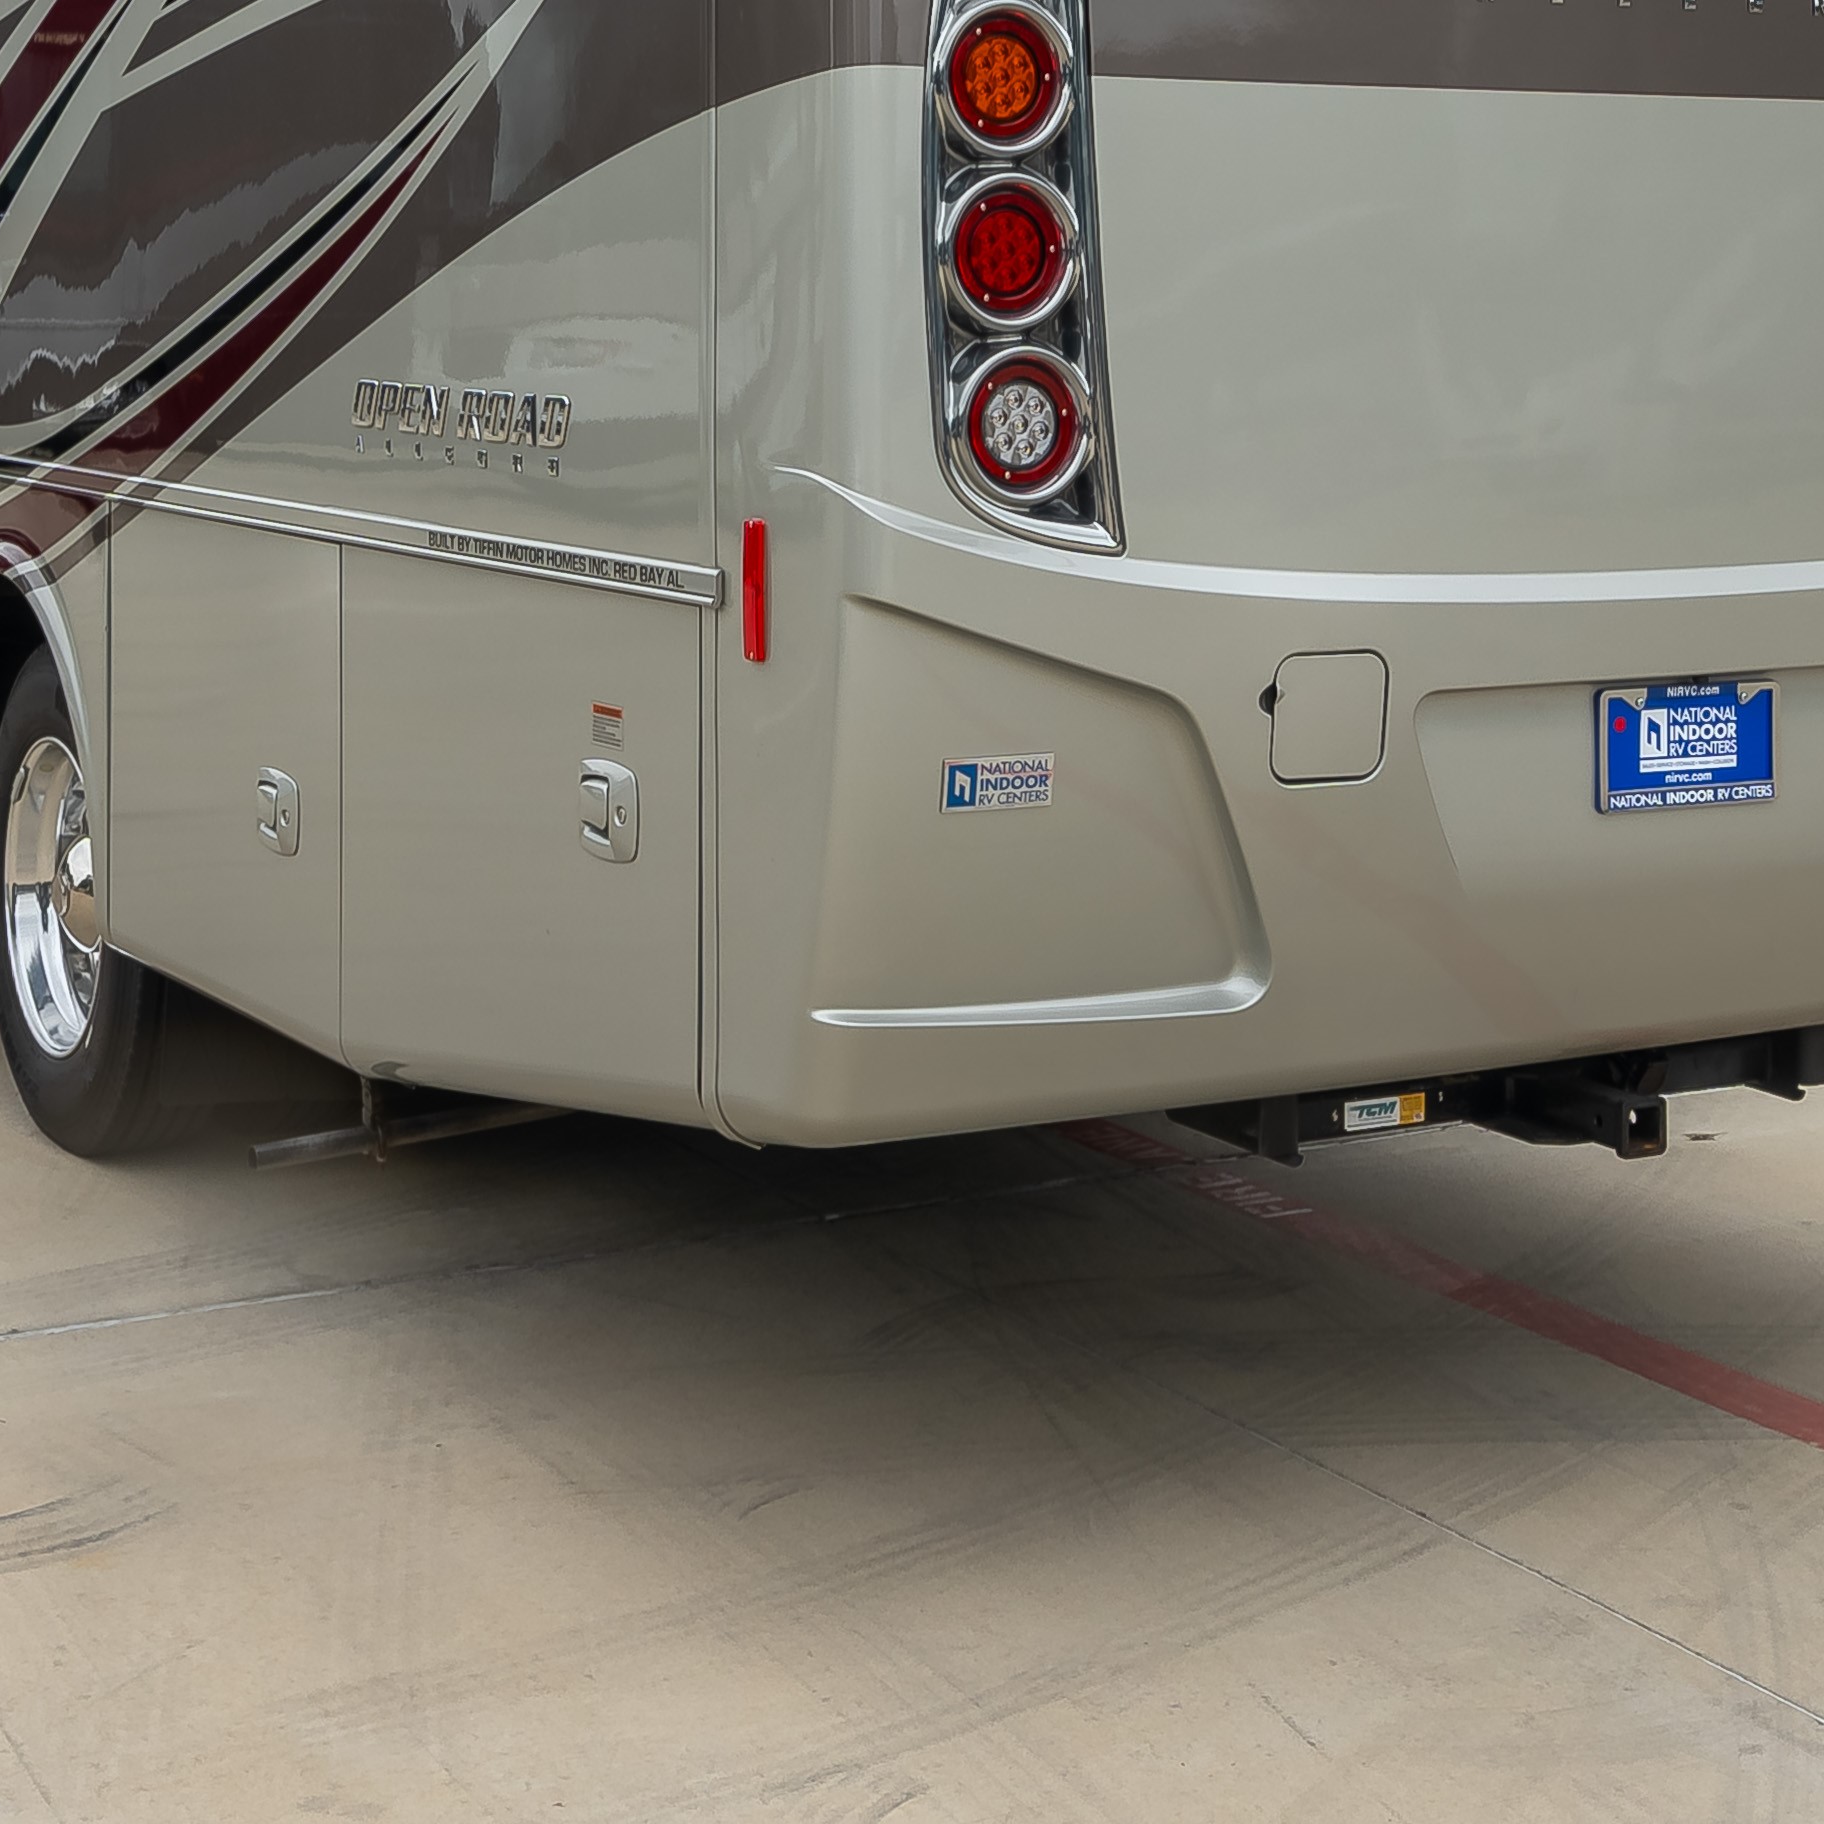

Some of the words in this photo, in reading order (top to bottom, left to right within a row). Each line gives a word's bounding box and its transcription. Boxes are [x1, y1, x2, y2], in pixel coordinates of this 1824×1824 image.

[352, 379, 450, 437] OPEN
[456, 388, 572, 449] ROAD
[429, 531, 456, 550] BUILT
[457, 535, 471, 552] BY
[474, 537, 504, 558] TIFFIN
[506, 542, 544, 564] MOTOR
[547, 549, 587, 572] HOMES
[613, 562, 638, 581] RED
[640, 566, 665, 585] BAY
[1667, 685, 1720, 698] NIRVC.com
[1670, 705, 1737, 723] NATIONAL
[1670, 723, 1737, 741] INDOOR
[1669, 742, 1686, 756] RV
[1687, 740, 1737, 756] CENTERS
[981, 759, 1049, 776] NATIONAL
[979, 774, 1049, 792] INDOOR
[1665, 772, 1712, 783] nirvc.com
[978, 793, 995, 806] RV
[997, 789, 1049, 805] CENTERS
[1610, 792, 1663, 809] NATIONAL
[1666, 789, 1715, 804] INDOOR
[1717, 788, 1731, 800] RV
[1732, 784, 1774, 799] CENTERS
